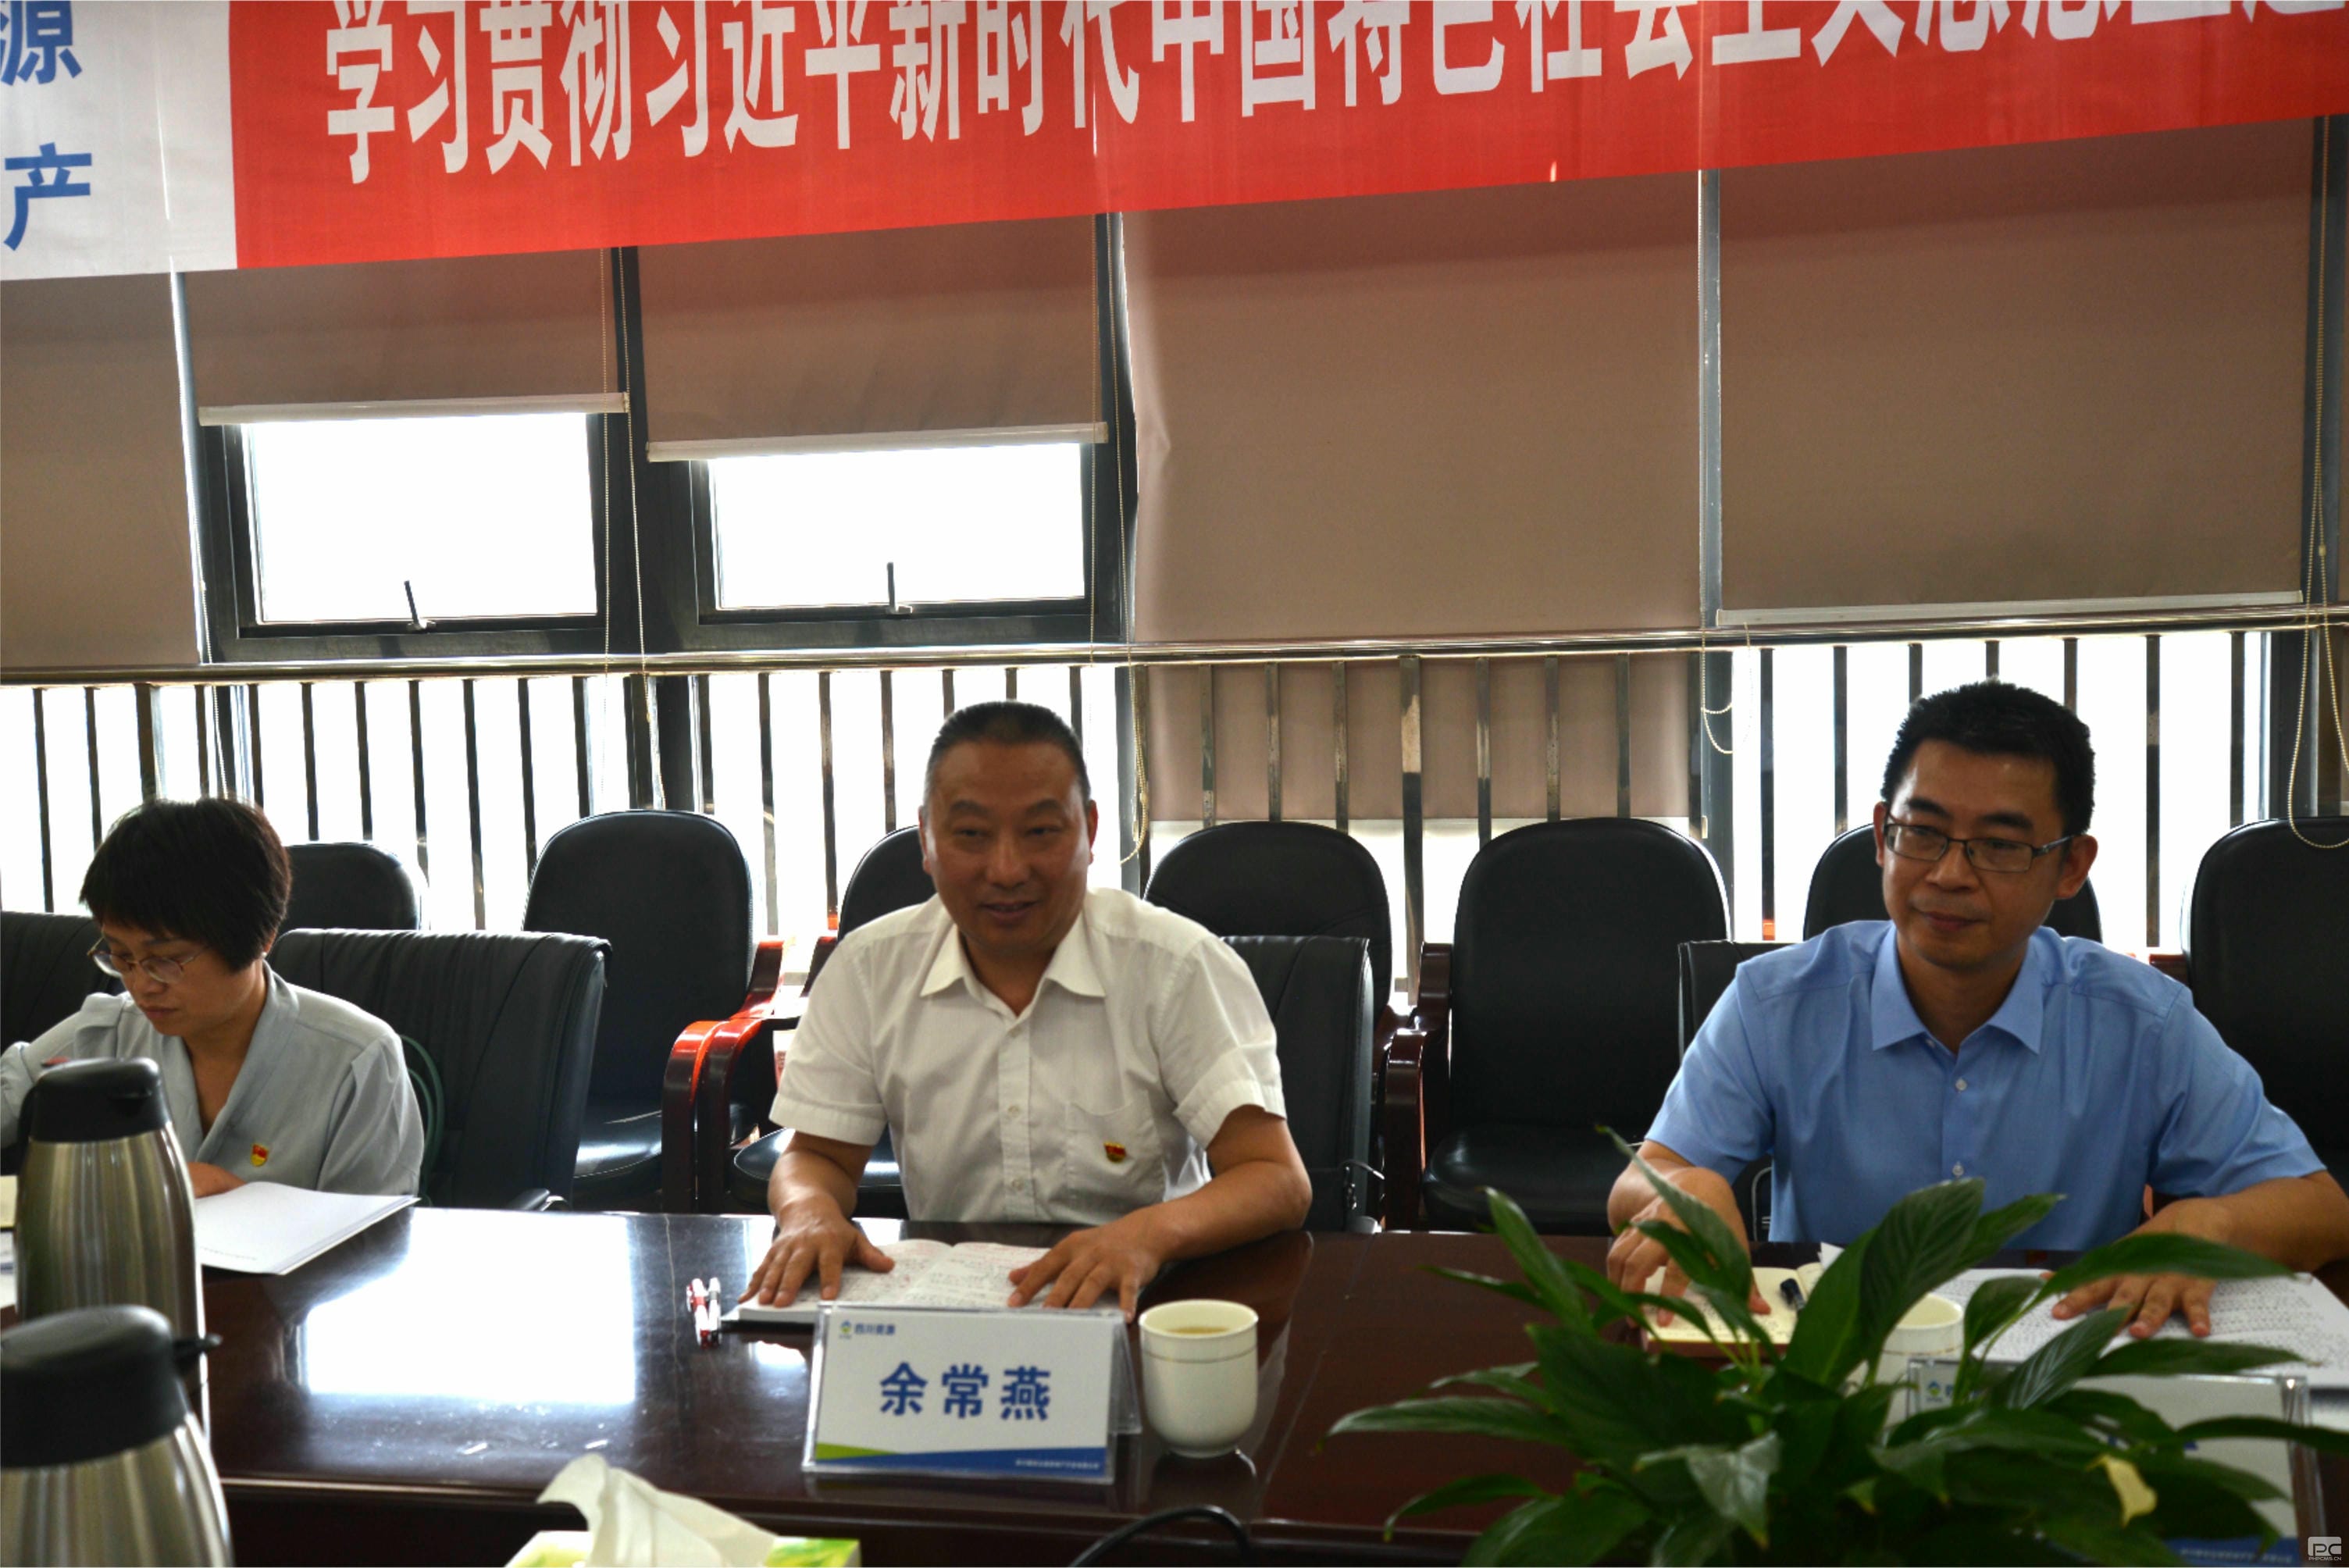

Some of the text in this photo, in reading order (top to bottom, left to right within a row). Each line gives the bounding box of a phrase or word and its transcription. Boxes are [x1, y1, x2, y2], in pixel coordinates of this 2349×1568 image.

[4, 141, 92, 251] 产
[879, 1361, 1052, 1421] 余常燕
